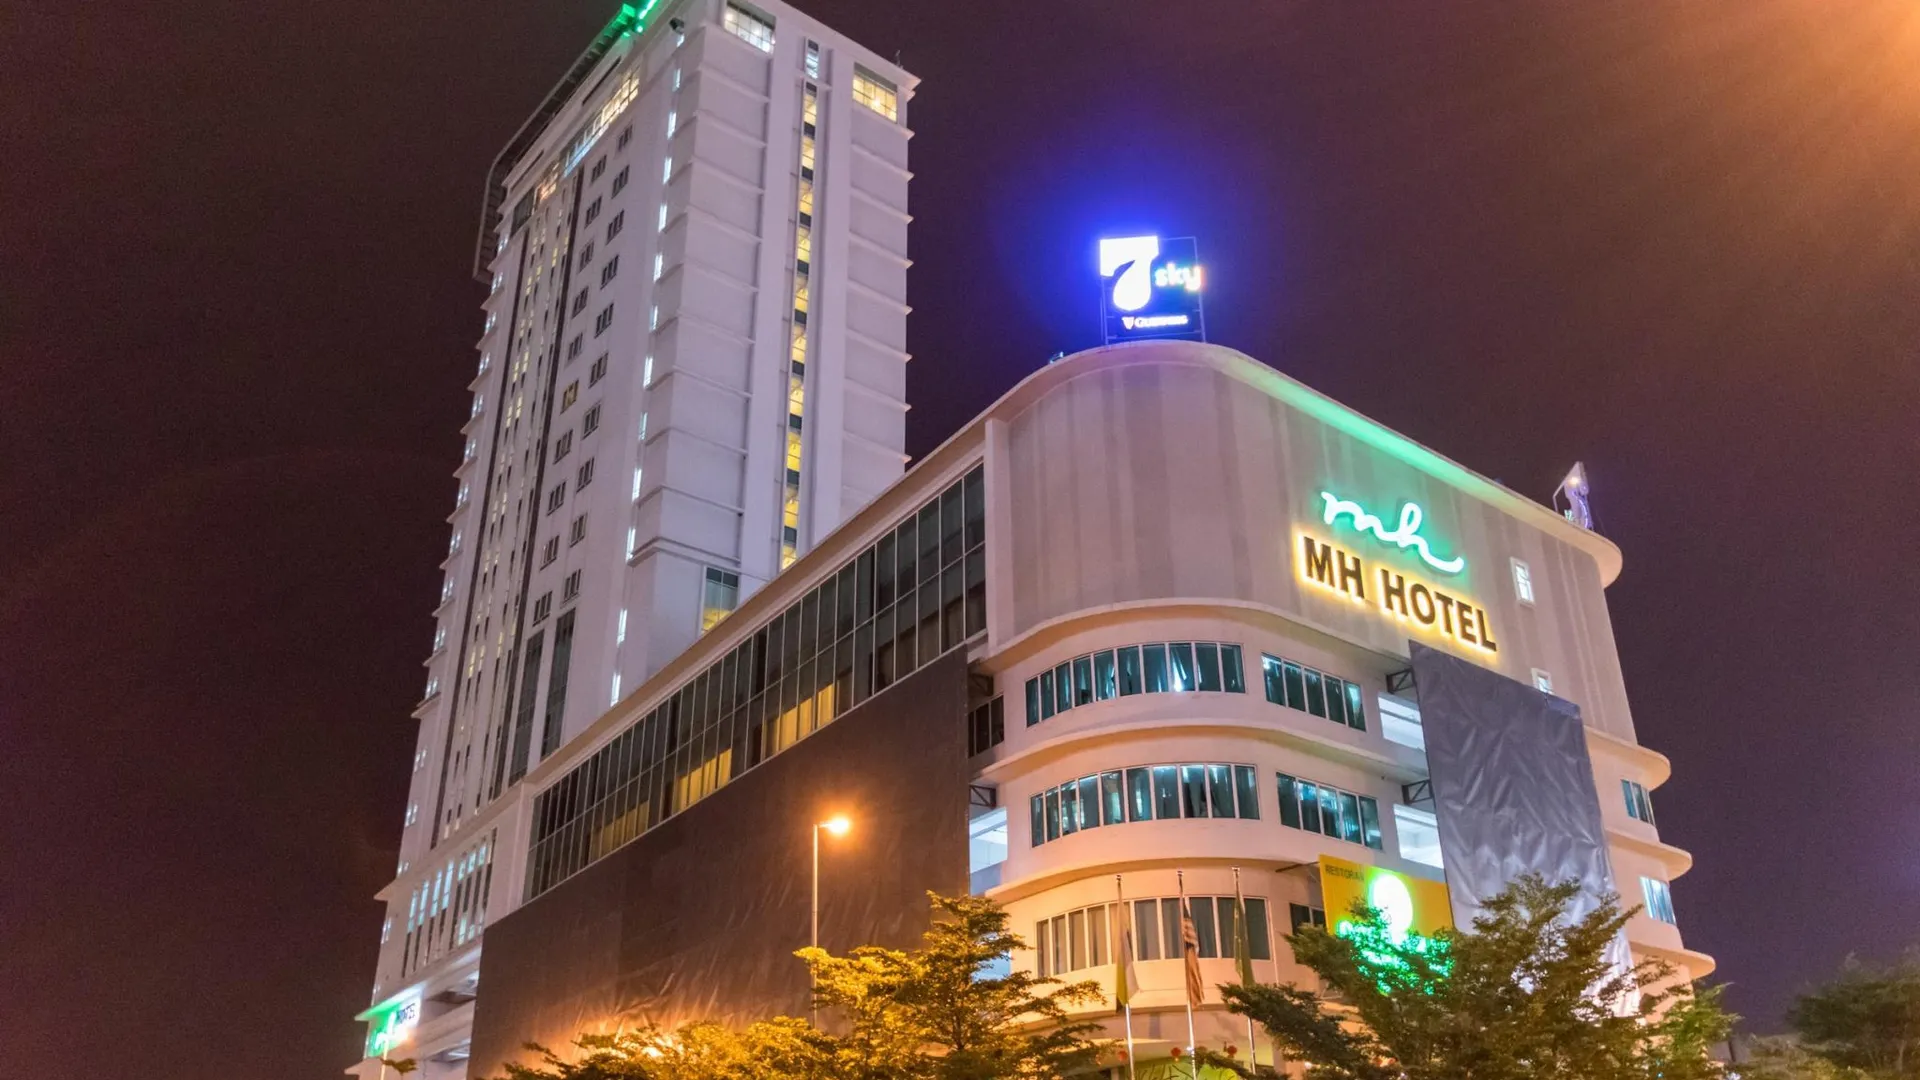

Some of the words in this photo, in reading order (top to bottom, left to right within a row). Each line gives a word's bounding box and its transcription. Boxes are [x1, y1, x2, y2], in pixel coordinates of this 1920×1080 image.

[1100, 236, 1159, 311] 7
[1154, 262, 1204, 292] sky
[1303, 536, 1365, 599] MH
[1380, 568, 1498, 652] HOTEL
